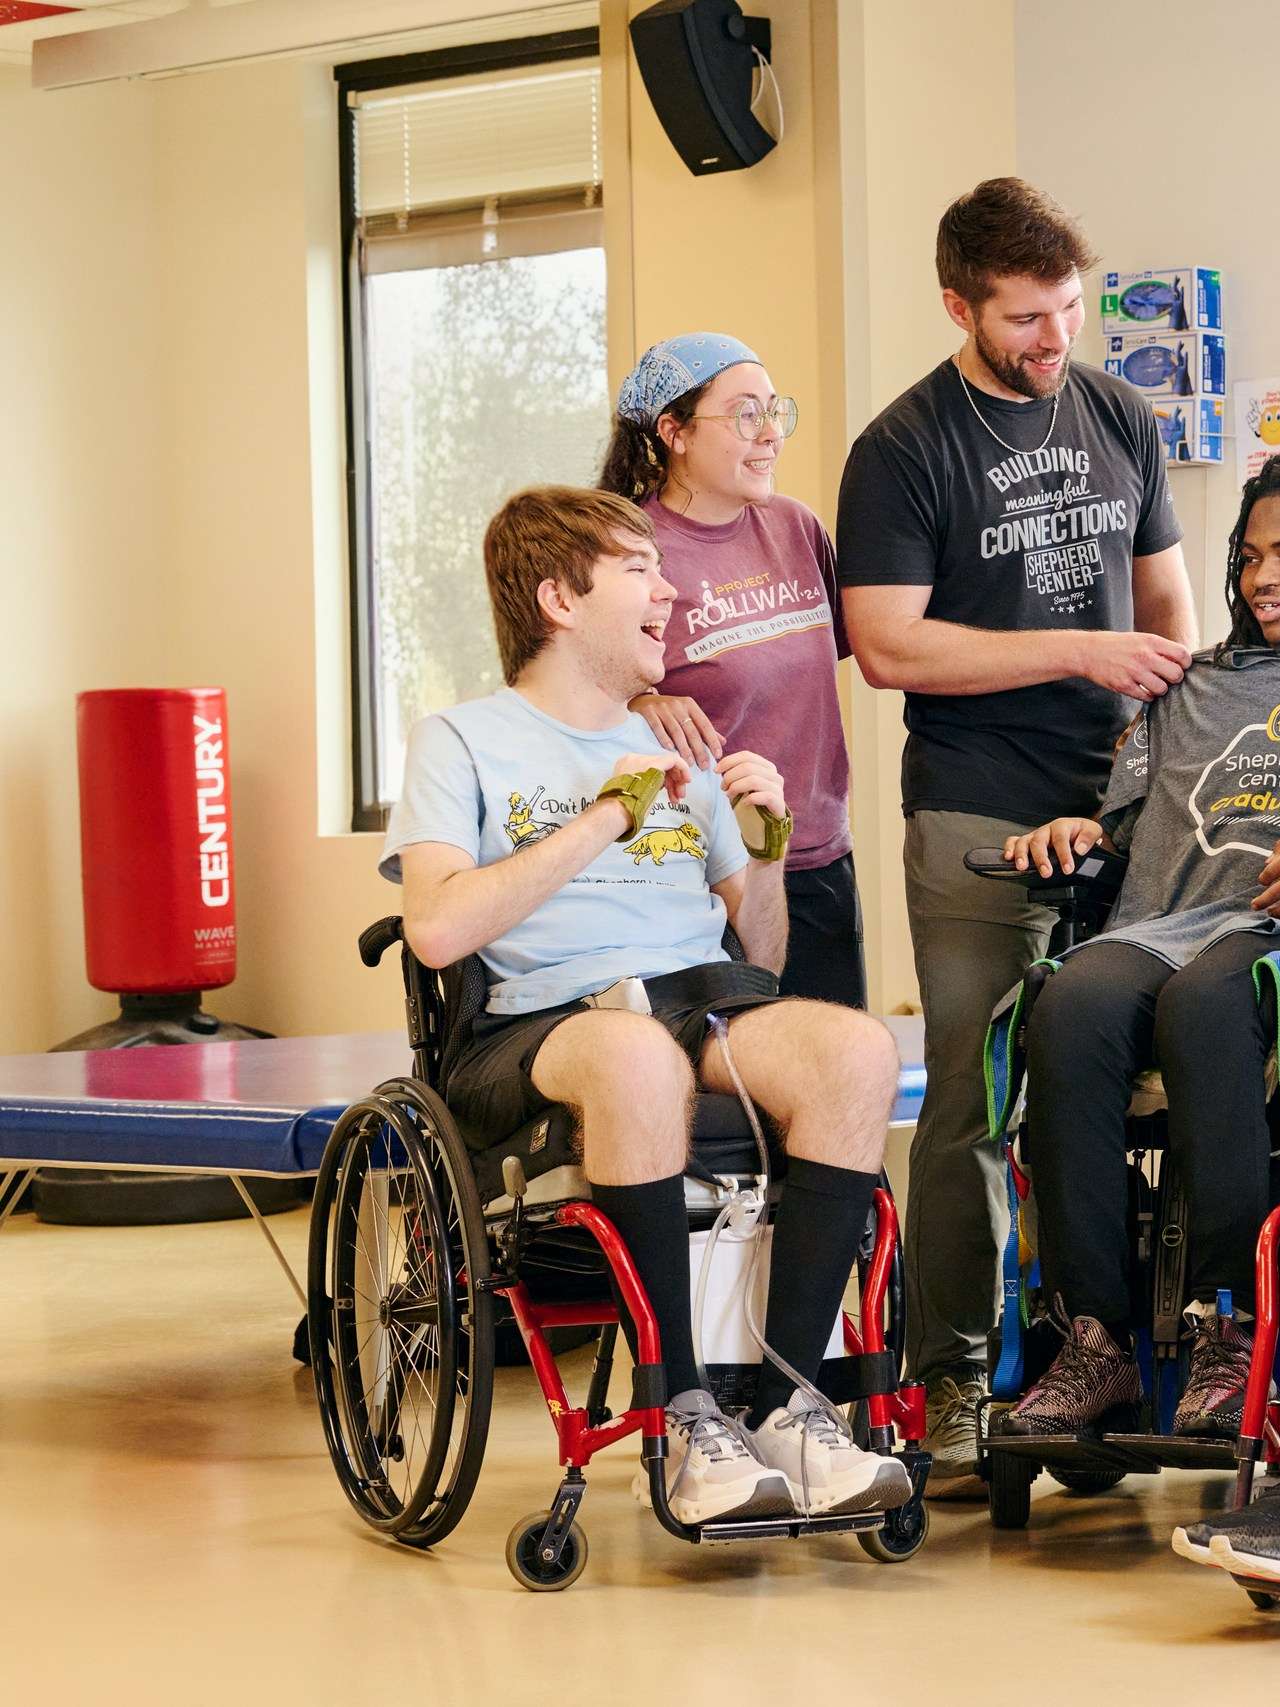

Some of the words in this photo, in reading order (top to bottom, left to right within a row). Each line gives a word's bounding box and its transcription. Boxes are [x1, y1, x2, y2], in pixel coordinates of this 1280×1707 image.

[1106, 297, 1113, 311] L
[1108, 360, 1119, 375] M
[987, 447, 1090, 493] BUILDING
[1005, 475, 1090, 510] meaningful
[980, 499, 1127, 559] CONNECTIONS
[1028, 542, 1100, 576] SHEPHERD
[714, 572, 771, 596] PROJECT
[1036, 565, 1095, 595] CENTER
[686, 579, 800, 634] ROLLWAY
[1053, 595, 1070, 605] Since
[1070, 591, 1085, 601] 1975
[692, 631, 743, 656] IMAGINE
[748, 624, 765, 637] THE
[193, 714, 230, 908] CENTURY
[541, 798, 578, 815] Don't
[194, 925, 234, 941] WAVE
